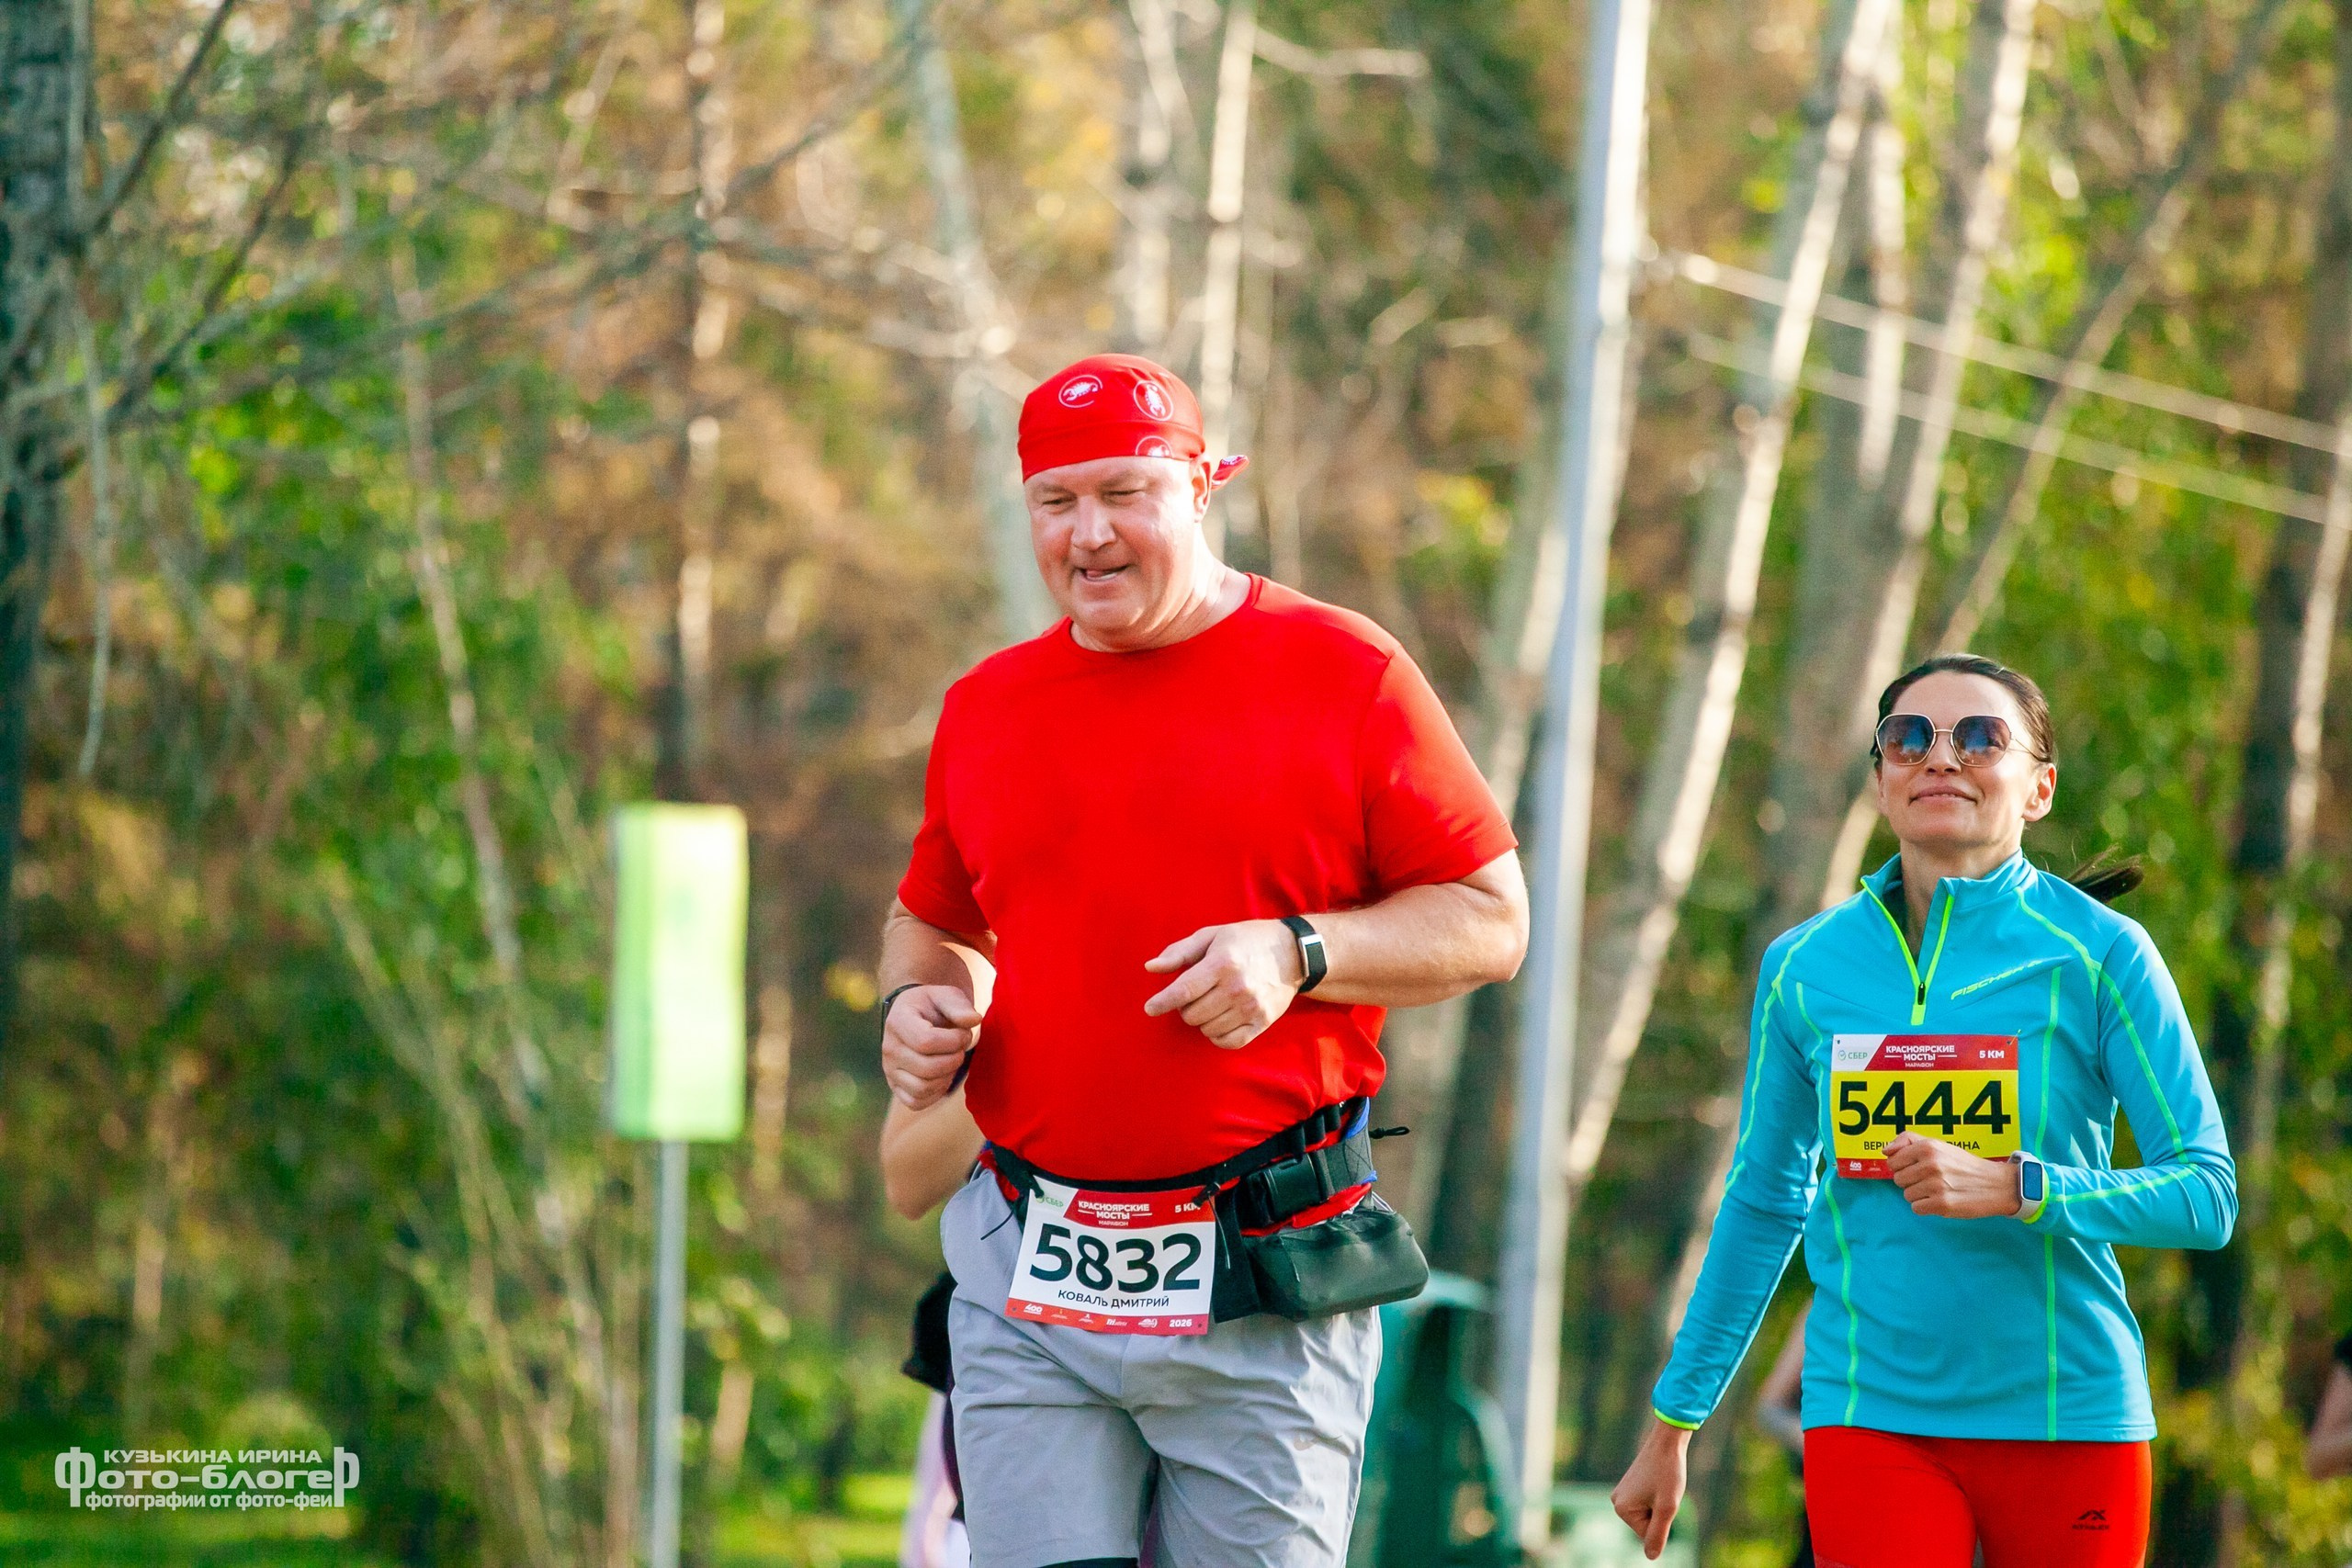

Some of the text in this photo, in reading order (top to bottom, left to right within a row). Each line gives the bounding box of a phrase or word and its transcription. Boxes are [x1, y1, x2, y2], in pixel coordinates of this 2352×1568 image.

[1885, 1045, 1955, 1054] КРАСНОЯРСКИЕ
[1903, 1053, 1936, 1061] МОСТЫ
[1979, 1050, 2005, 1059] 5 КМ
[1838, 1080, 2011, 1135] 5444
[1078, 1201, 1150, 1212] КРАСНОЯРСКИЕ
[1174, 1204, 1182, 1213] 5
[1096, 1211, 1130, 1220] МОСТЫ
[1029, 1223, 1202, 1293] 5832
[1057, 1290, 1170, 1309] КОВАЛЬ ДМИТРИЙ
[1169, 1319, 1193, 1327] 2026
